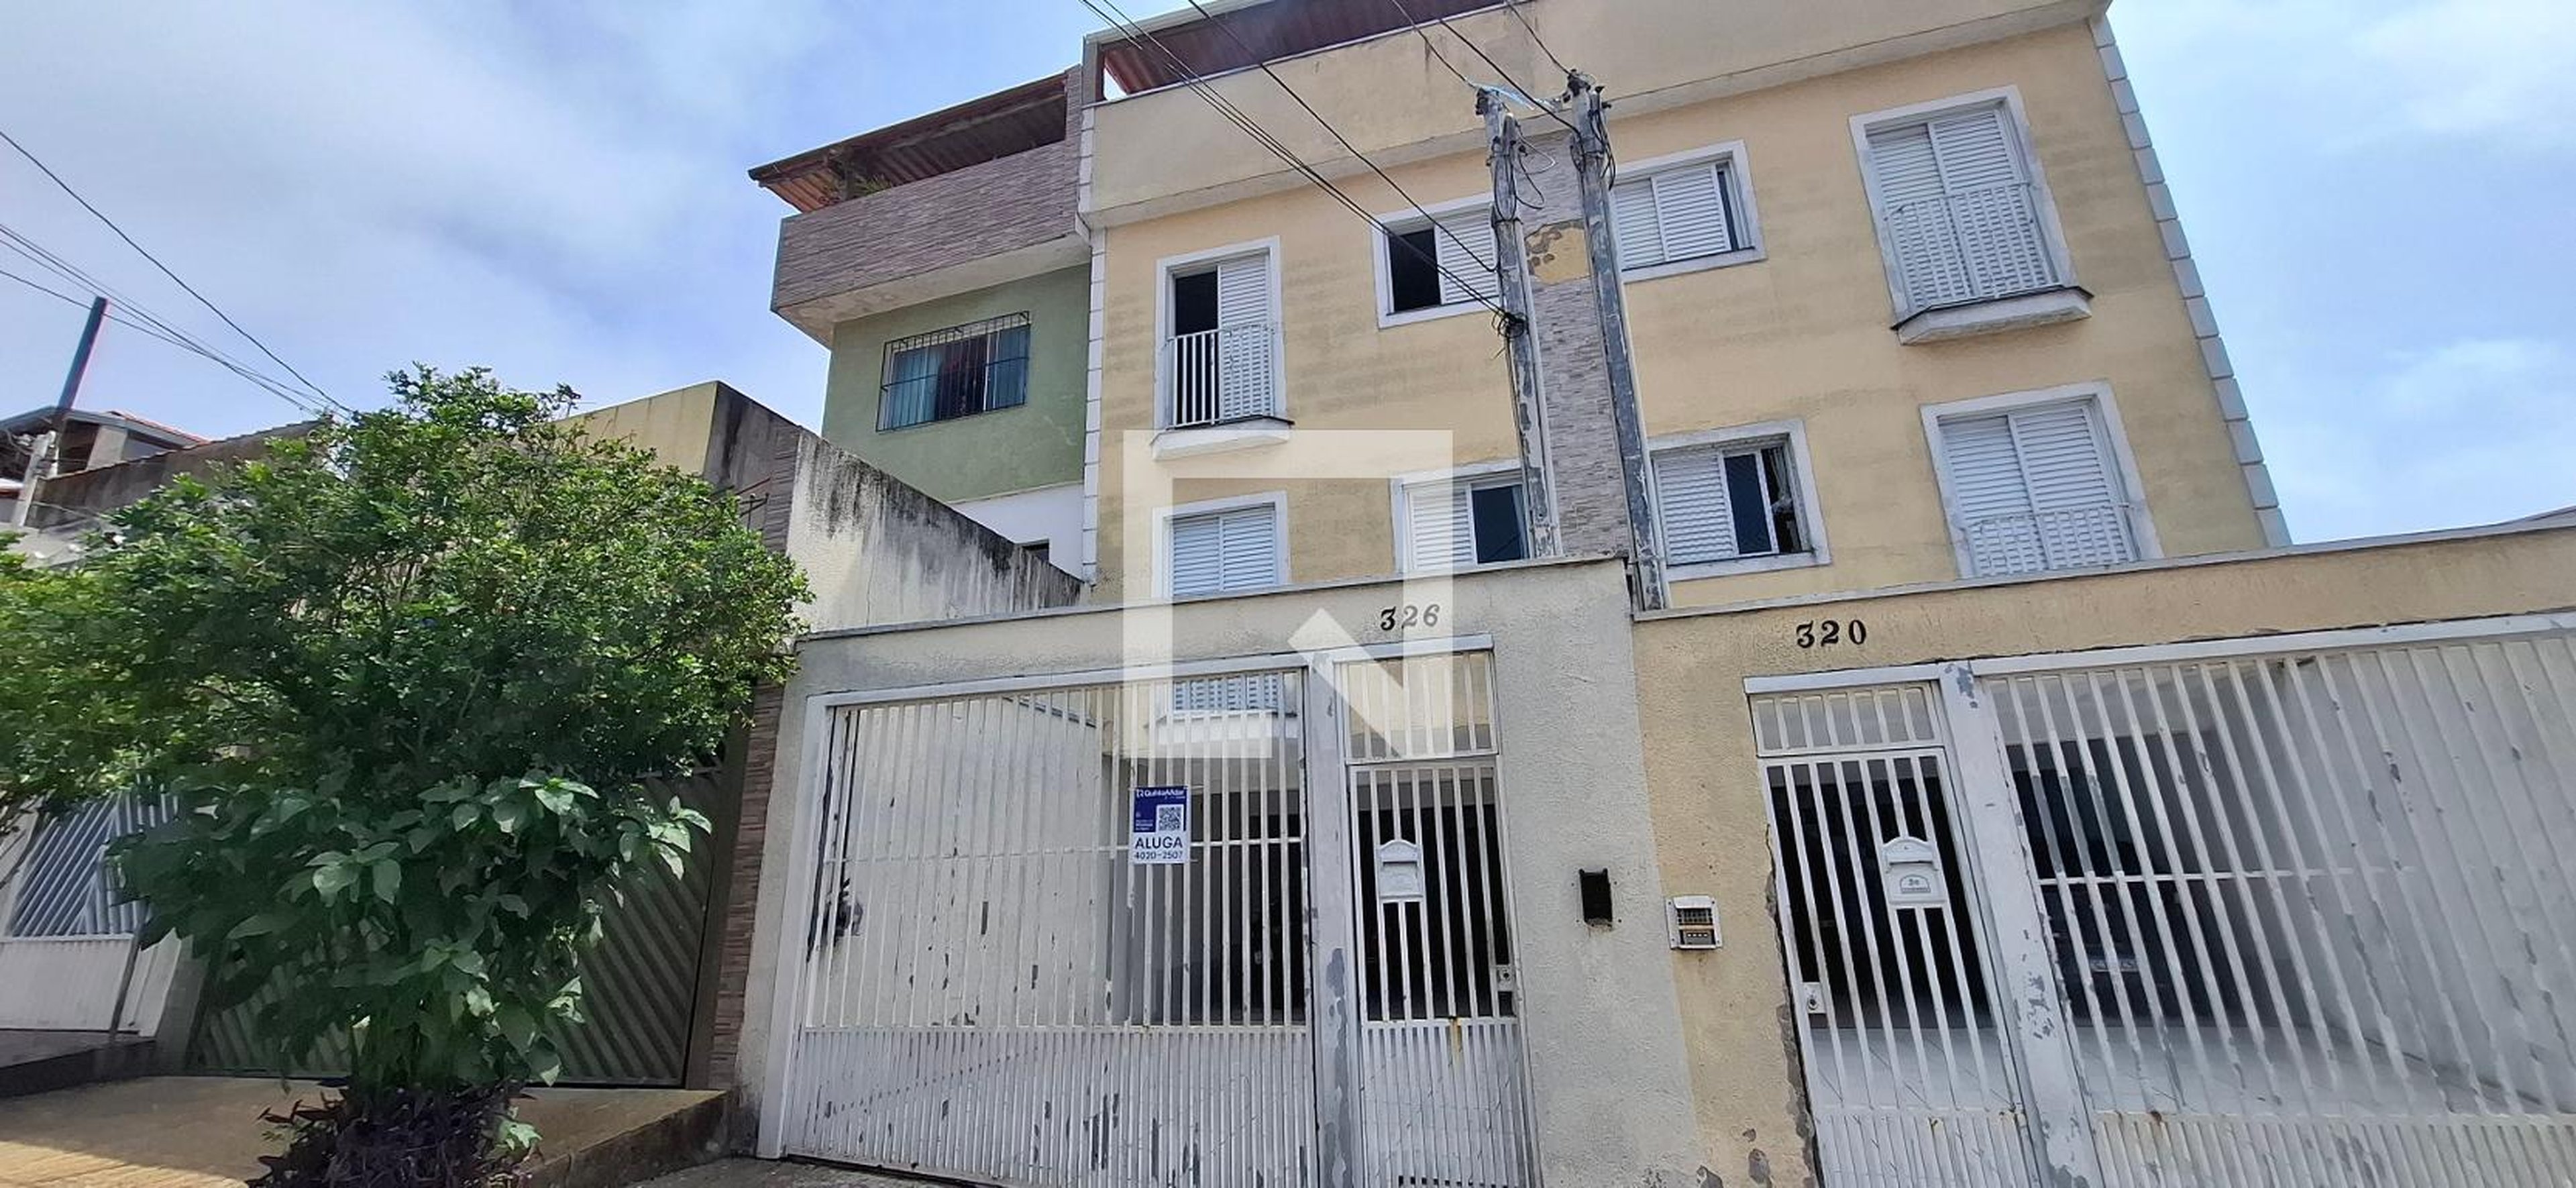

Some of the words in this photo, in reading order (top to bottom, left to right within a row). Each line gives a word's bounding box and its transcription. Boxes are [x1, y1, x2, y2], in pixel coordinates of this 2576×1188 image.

[1380, 604, 1440, 631] 326
[1796, 619, 1867, 648] 320
[1135, 836, 1183, 849] ALUGA
[1134, 851, 1183, 859] 4020-2507
